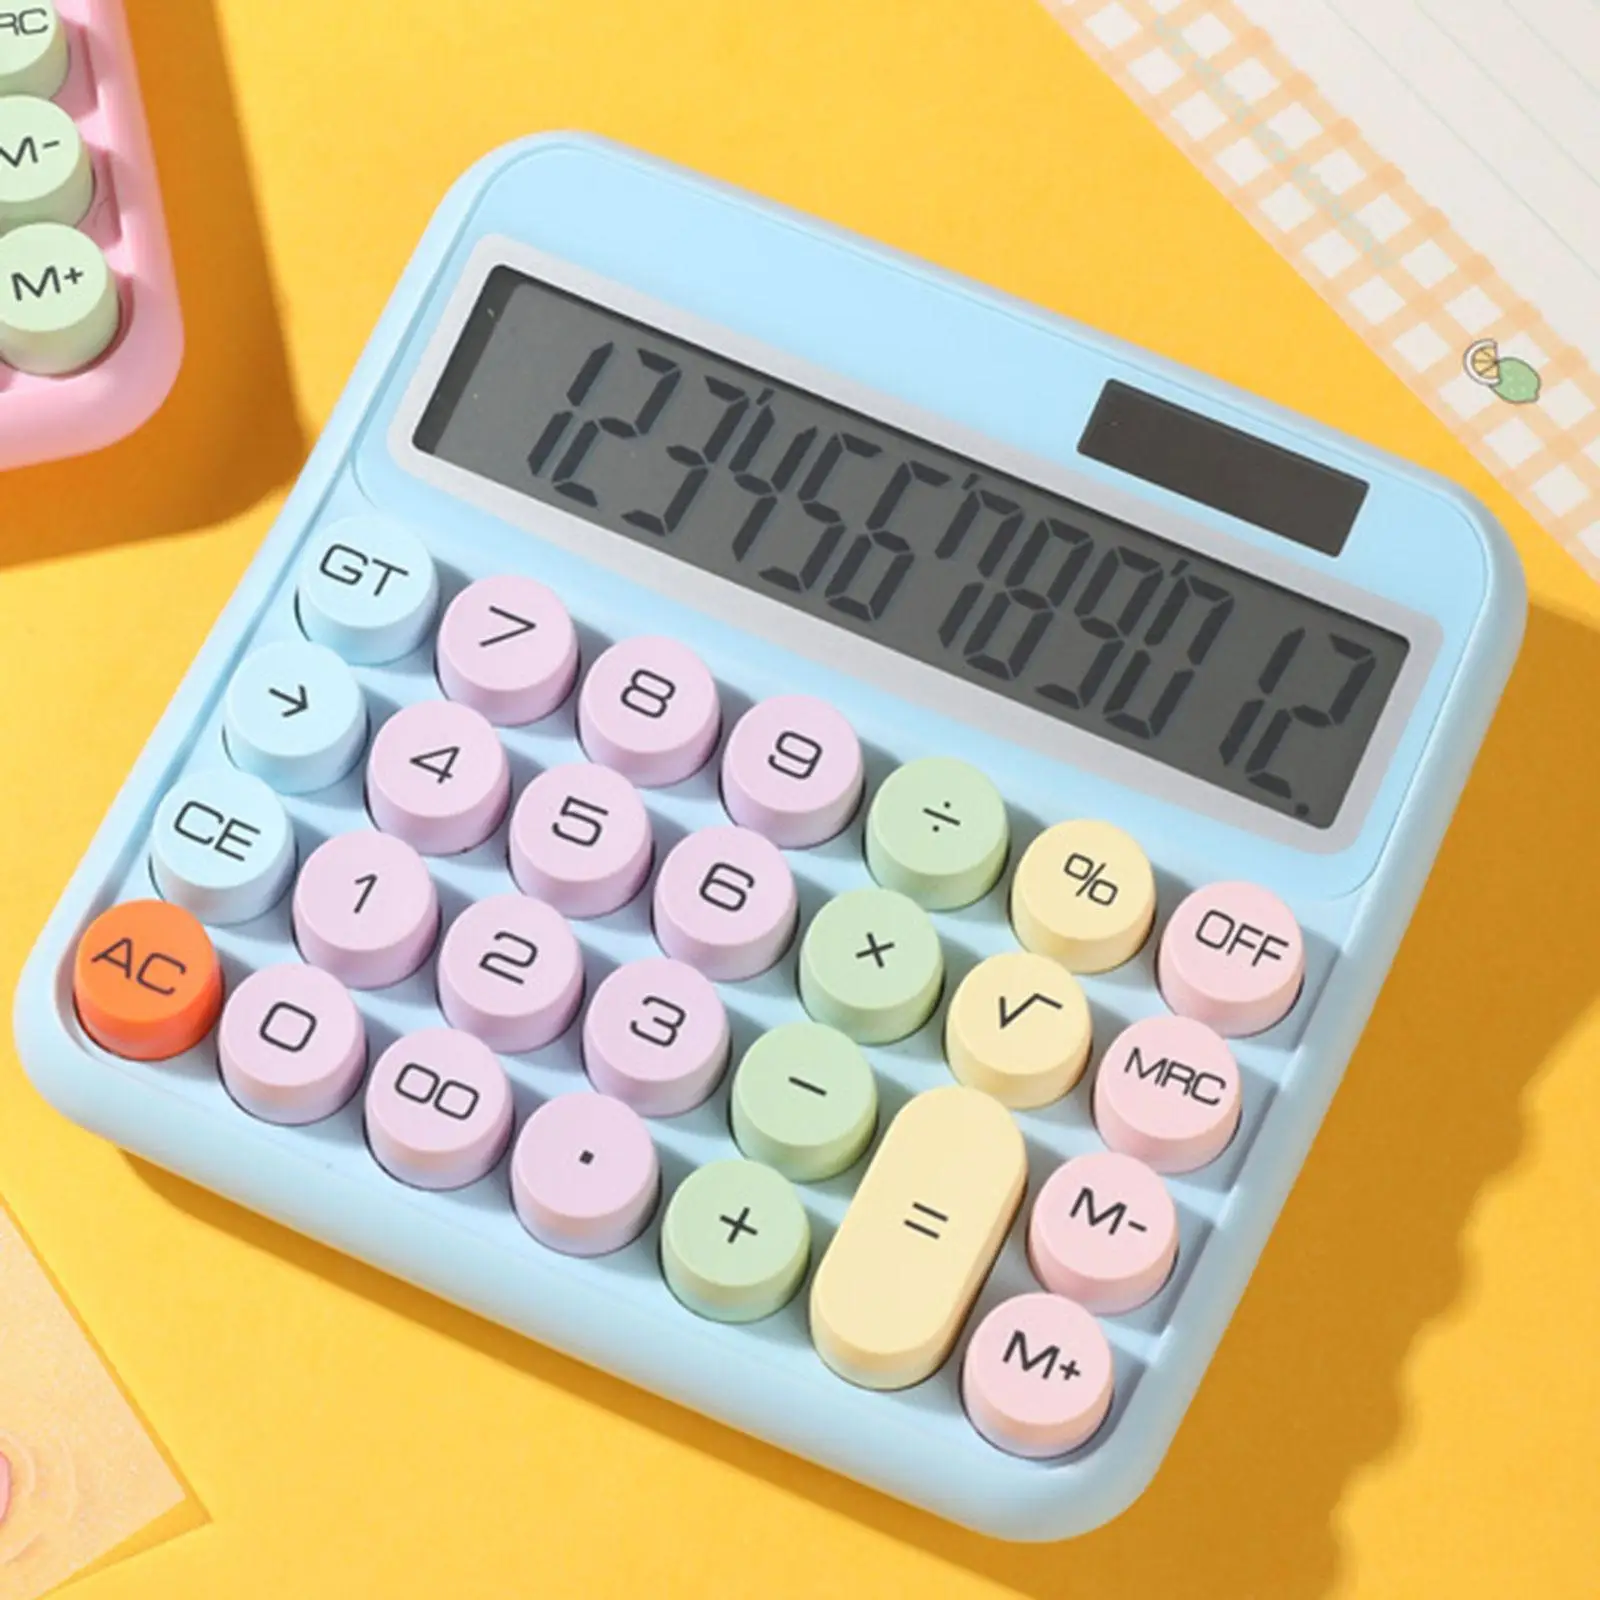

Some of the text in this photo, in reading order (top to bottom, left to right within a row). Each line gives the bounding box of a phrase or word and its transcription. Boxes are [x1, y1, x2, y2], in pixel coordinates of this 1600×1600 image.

[11, 266, 84, 301] M+
[319, 543, 409, 597] GT
[479, 605, 537, 648] 7
[619, 668, 677, 719] 8
[409, 745, 460, 785] 4
[767, 730, 823, 780] 9
[173, 800, 261, 862] CE
[551, 795, 609, 848] 5
[353, 873, 378, 914] 1
[698, 861, 756, 913] 6
[1063, 852, 1119, 907] %
[478, 931, 539, 985] 2
[1194, 909, 1290, 967] OFF
[91, 936, 187, 996] AC
[258, 1000, 318, 1053] 0
[629, 995, 687, 1048] 3
[394, 1062, 480, 1121] 00
[1123, 1046, 1227, 1106] MRC
[1069, 1186, 1147, 1236] M-
[1002, 1329, 1081, 1381] M+
